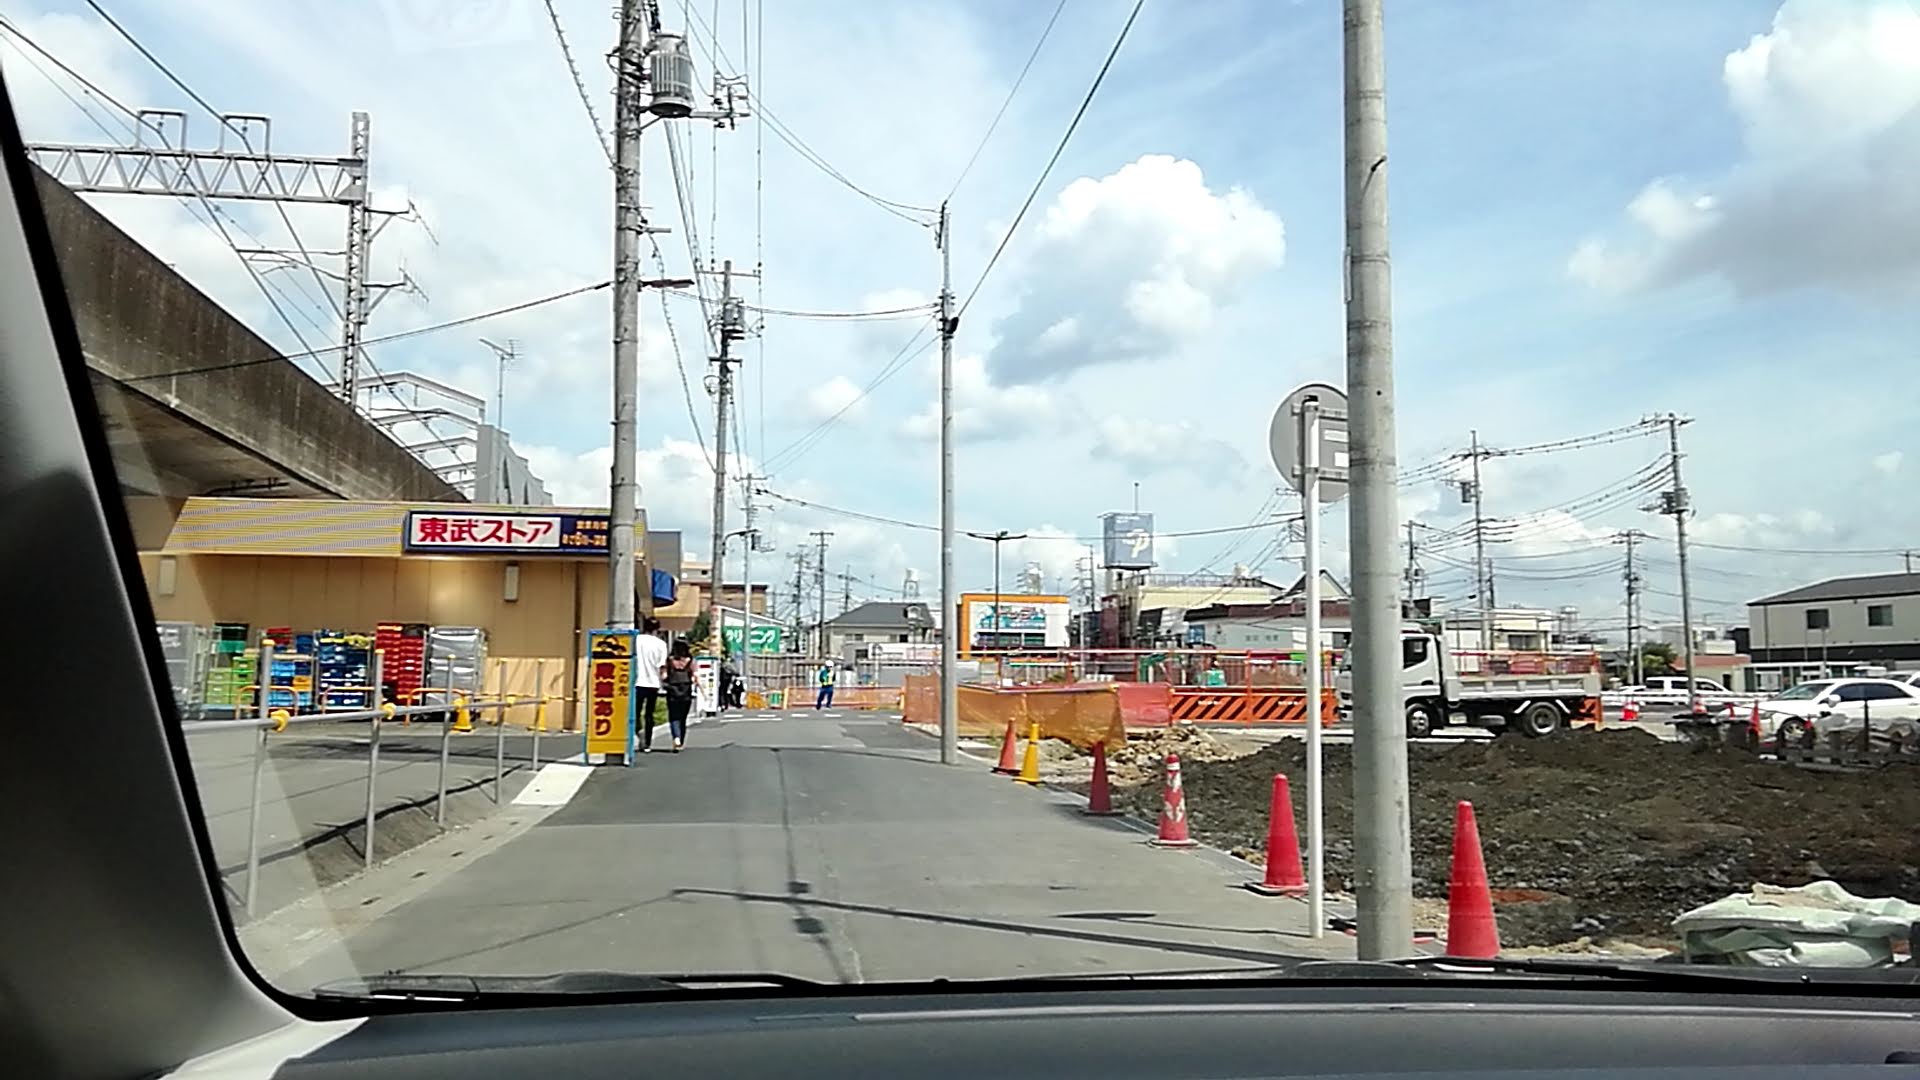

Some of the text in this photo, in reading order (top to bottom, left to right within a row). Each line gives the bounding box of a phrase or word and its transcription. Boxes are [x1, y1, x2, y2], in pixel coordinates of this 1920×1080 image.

[418, 517, 553, 544] 東武ストア
[724, 629, 777, 644] クリニング
